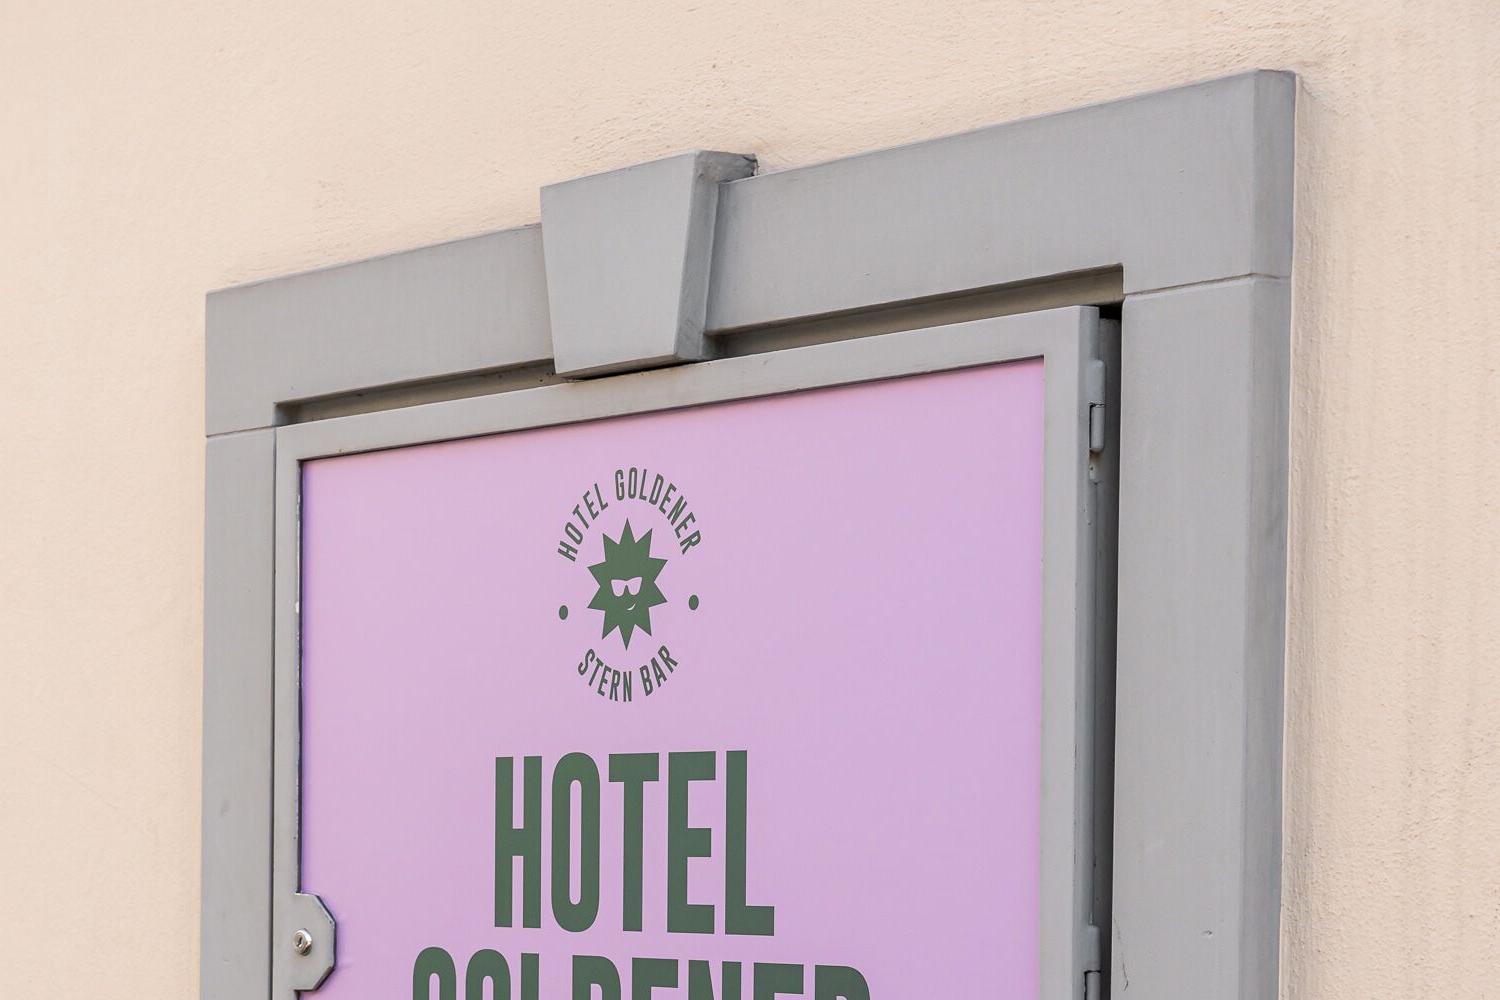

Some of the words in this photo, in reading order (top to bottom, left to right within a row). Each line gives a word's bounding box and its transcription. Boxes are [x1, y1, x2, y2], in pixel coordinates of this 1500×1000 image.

[557, 482, 609, 562] HOTEL
[614, 466, 702, 555] GOLDENER
[577, 648, 633, 702] STERN
[639, 644, 679, 697] BAR
[494, 749, 775, 937] HOTEL
